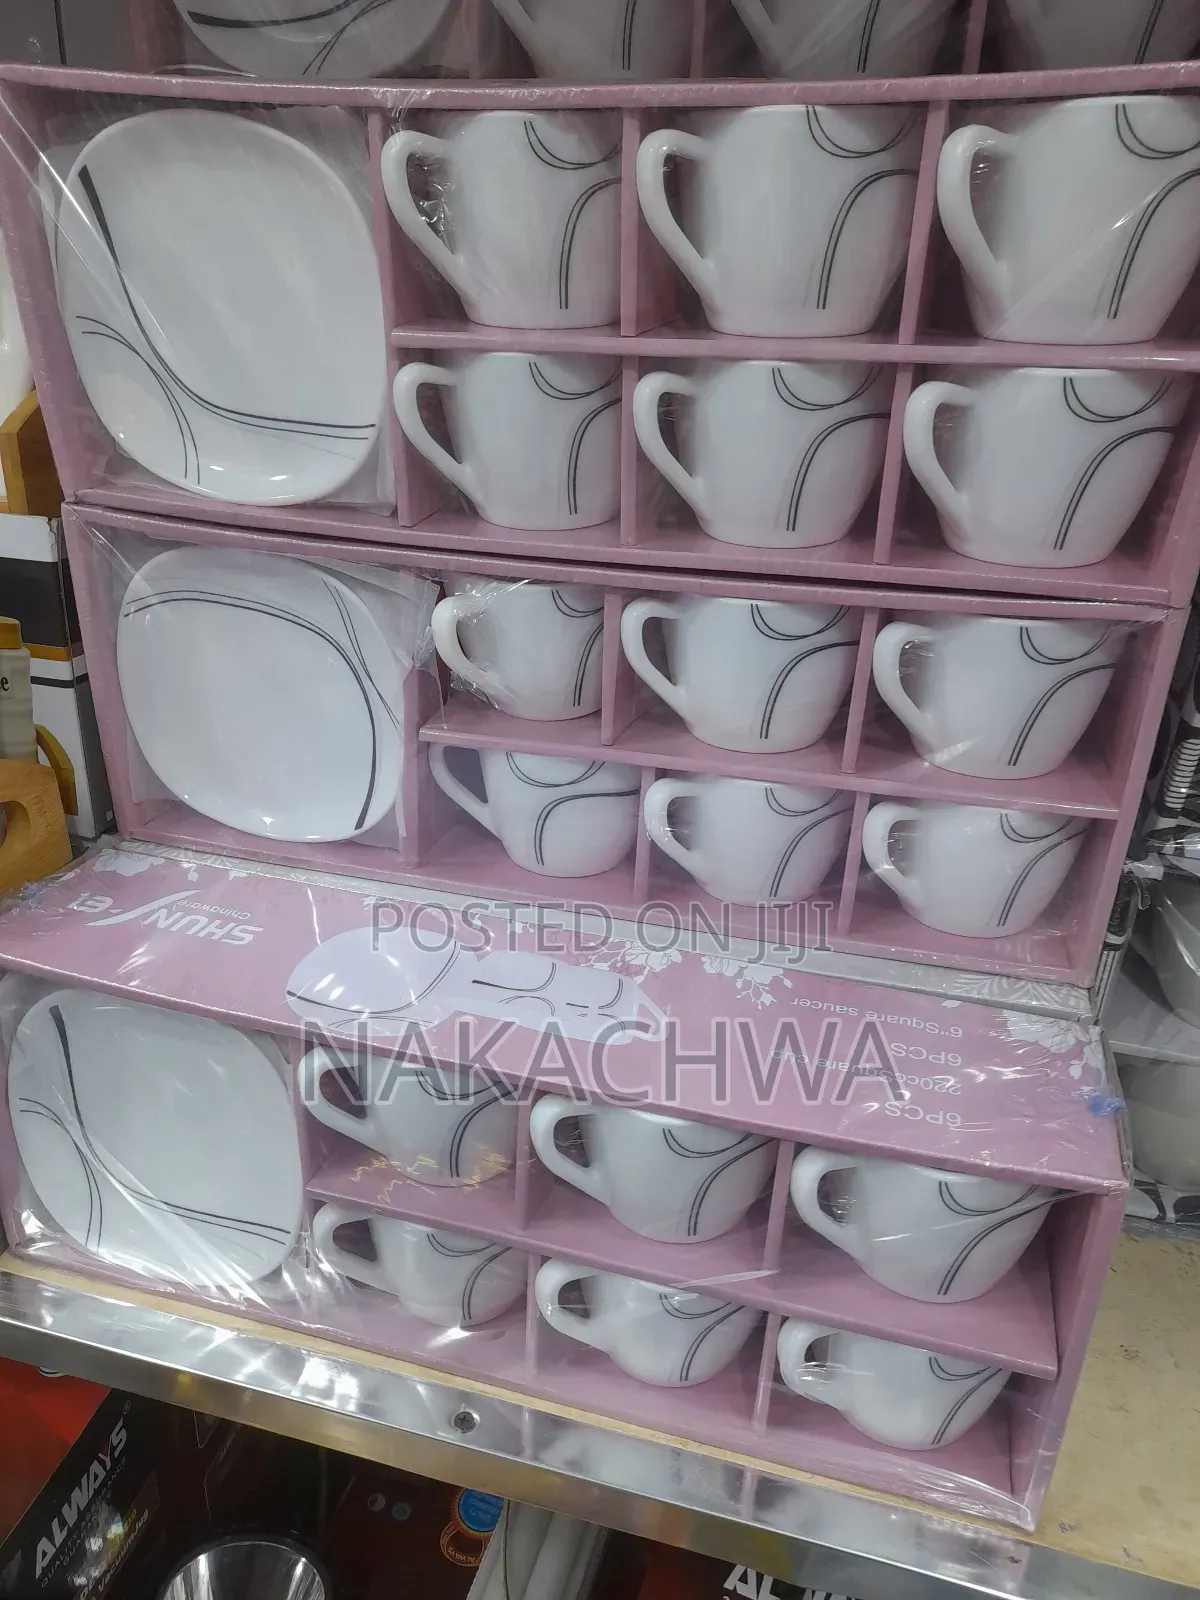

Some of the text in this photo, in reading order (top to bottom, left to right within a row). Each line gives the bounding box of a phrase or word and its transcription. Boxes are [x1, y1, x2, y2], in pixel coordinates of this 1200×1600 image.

[178, 899, 251, 920] Chinaware
[790, 997, 860, 1017] saucer
[889, 1042, 962, 1067] 6PCS
[885, 1101, 962, 1127] 6PCS
[36, 1416, 128, 1580] ALWAYS
[41, 1531, 79, 1588] QUALITY
[448, 1546, 476, 1563] ALWAYS
